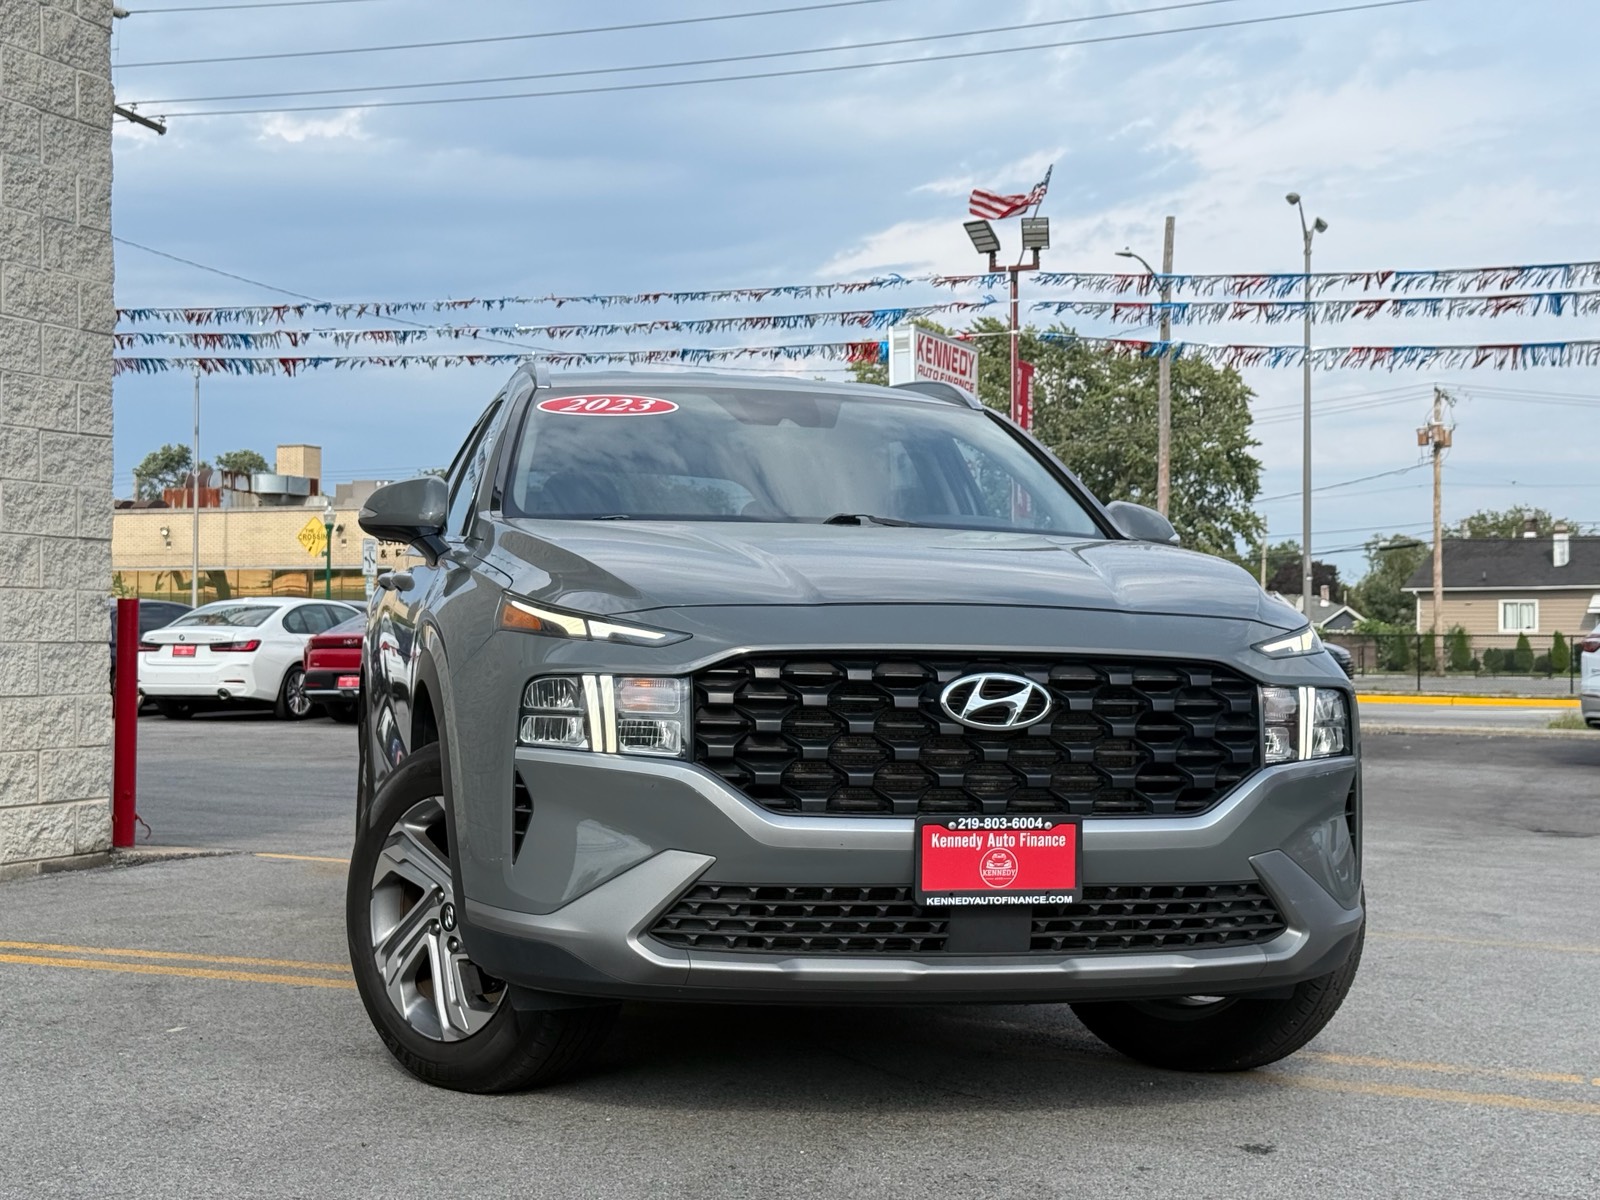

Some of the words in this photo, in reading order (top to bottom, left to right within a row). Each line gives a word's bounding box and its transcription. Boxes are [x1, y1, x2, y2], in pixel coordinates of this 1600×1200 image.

[917, 333, 976, 378] KENNEDY
[917, 364, 938, 380] AUTO
[940, 373, 975, 393] FINANCE
[559, 398, 657, 412] 2023
[957, 817, 1043, 830] 219-803-6004
[931, 833, 983, 850] Kennedy
[987, 833, 1016, 848] Auto
[1019, 833, 1066, 847] Finance
[982, 869, 1016, 877] KENNEDY
[926, 895, 1073, 906] KENNEDYAUTOFINANCE.COM
